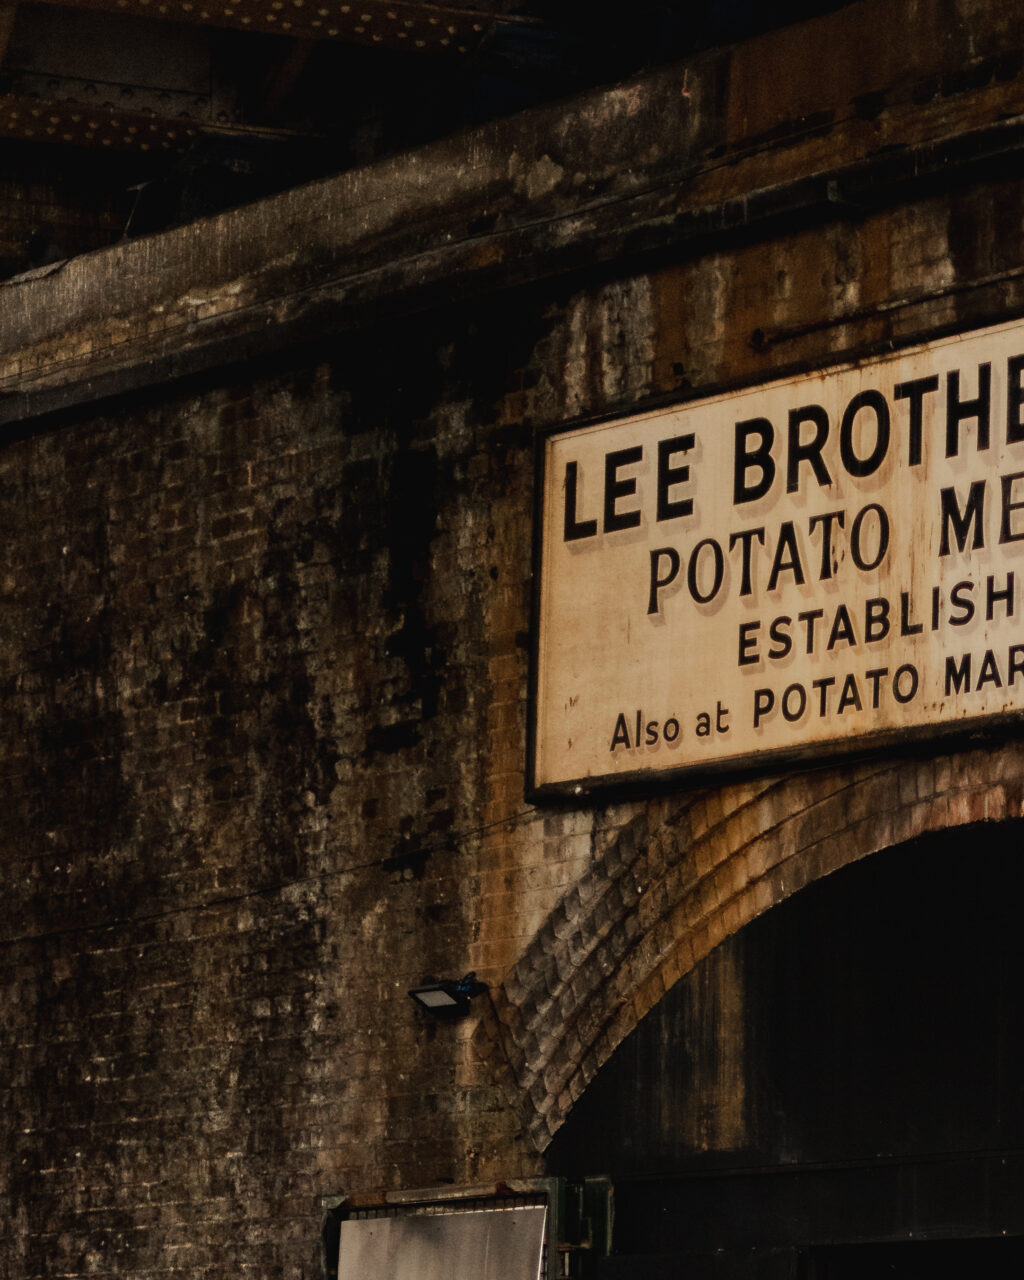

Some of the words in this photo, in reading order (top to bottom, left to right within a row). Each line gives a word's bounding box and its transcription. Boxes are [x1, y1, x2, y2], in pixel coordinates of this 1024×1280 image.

[562, 432, 697, 544] LEE
[646, 502, 891, 616] POTATO
[608, 708, 681, 752] Also
[694, 700, 731, 738] at
[752, 663, 920, 730] POTATO
